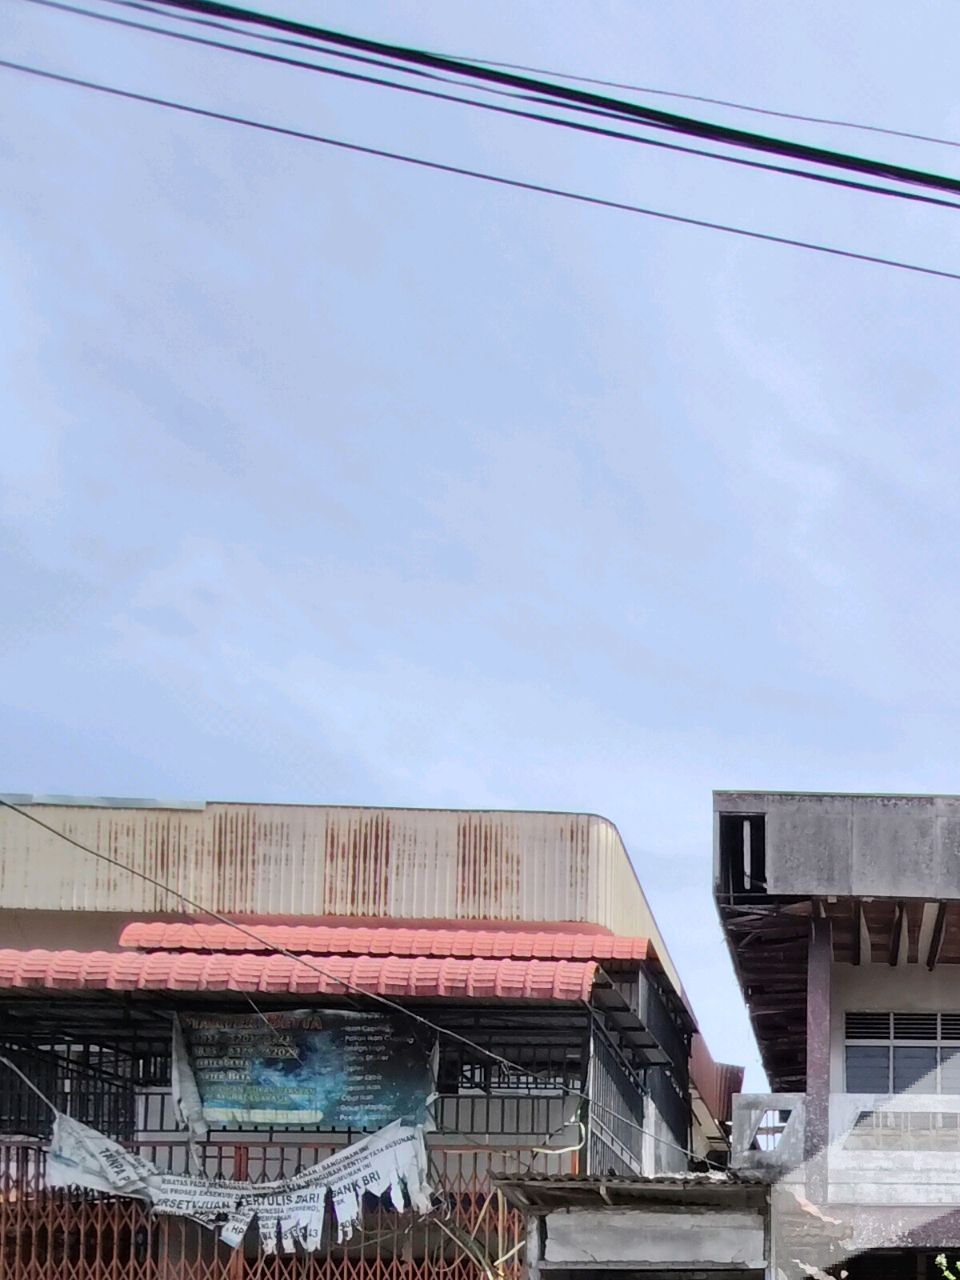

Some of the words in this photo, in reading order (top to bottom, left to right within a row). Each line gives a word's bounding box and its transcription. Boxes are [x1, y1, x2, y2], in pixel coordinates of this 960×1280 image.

[99, 1147, 126, 1176] TANPA
[295, 1193, 320, 1204] DARI
[361, 1170, 381, 1186] BRI
